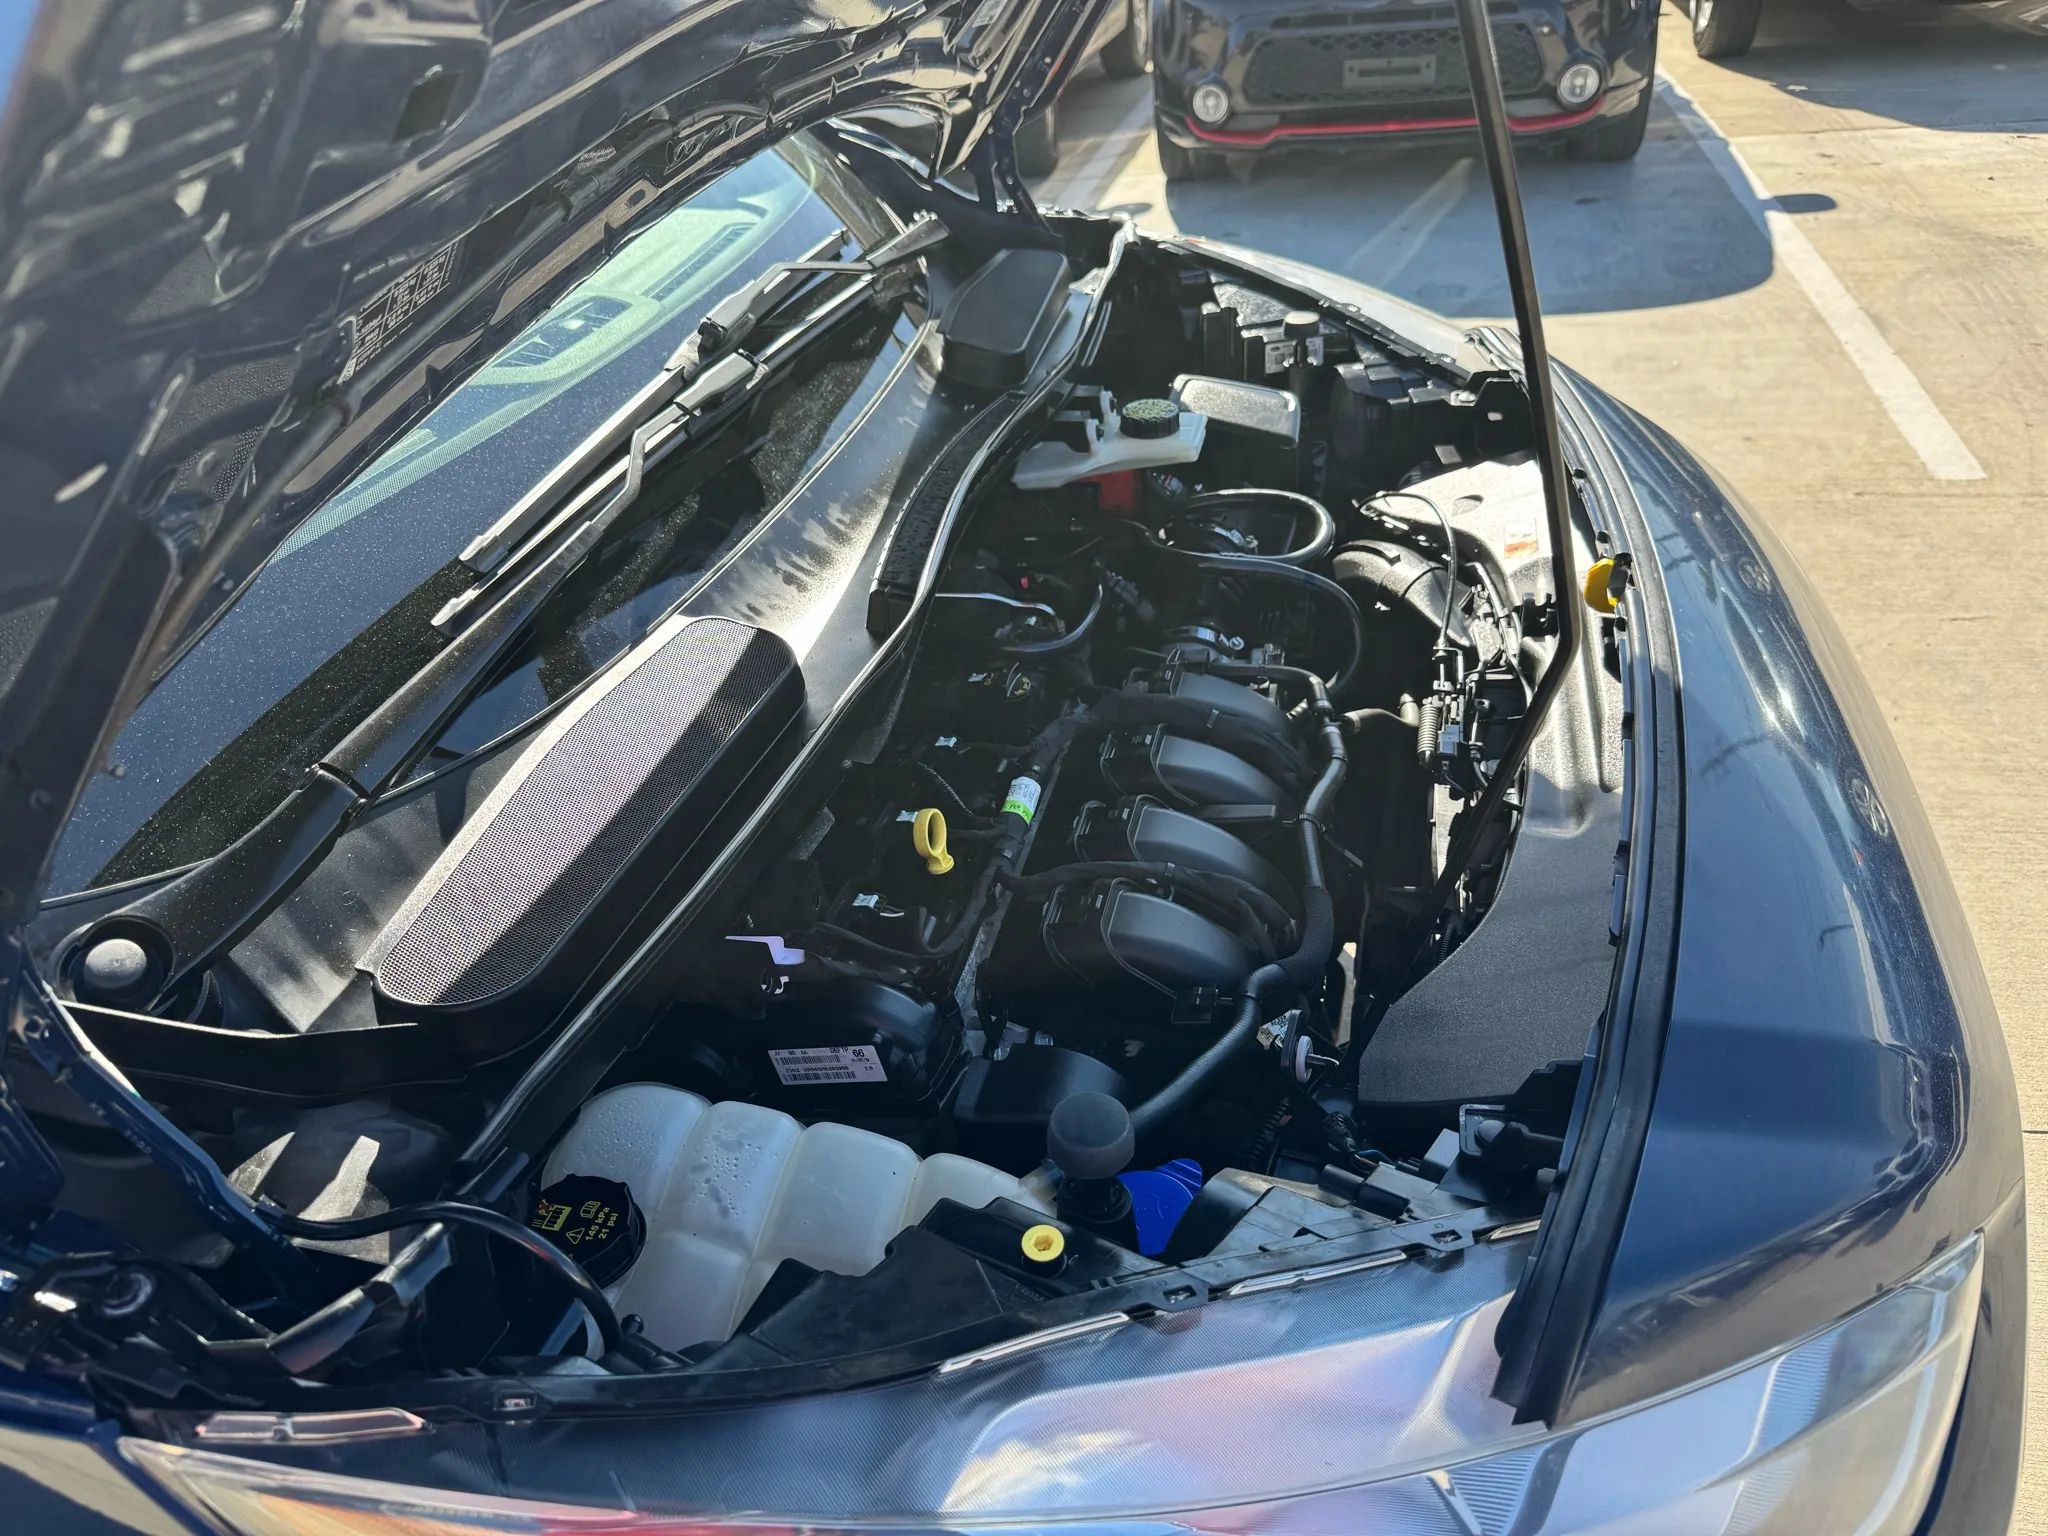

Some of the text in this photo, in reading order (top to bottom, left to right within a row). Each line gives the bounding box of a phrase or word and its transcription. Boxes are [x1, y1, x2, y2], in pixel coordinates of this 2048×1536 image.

[852, 1048, 865, 1058] 66
[585, 1207, 611, 1241] 145 kPa
[598, 1212, 619, 1240] 21 psi
